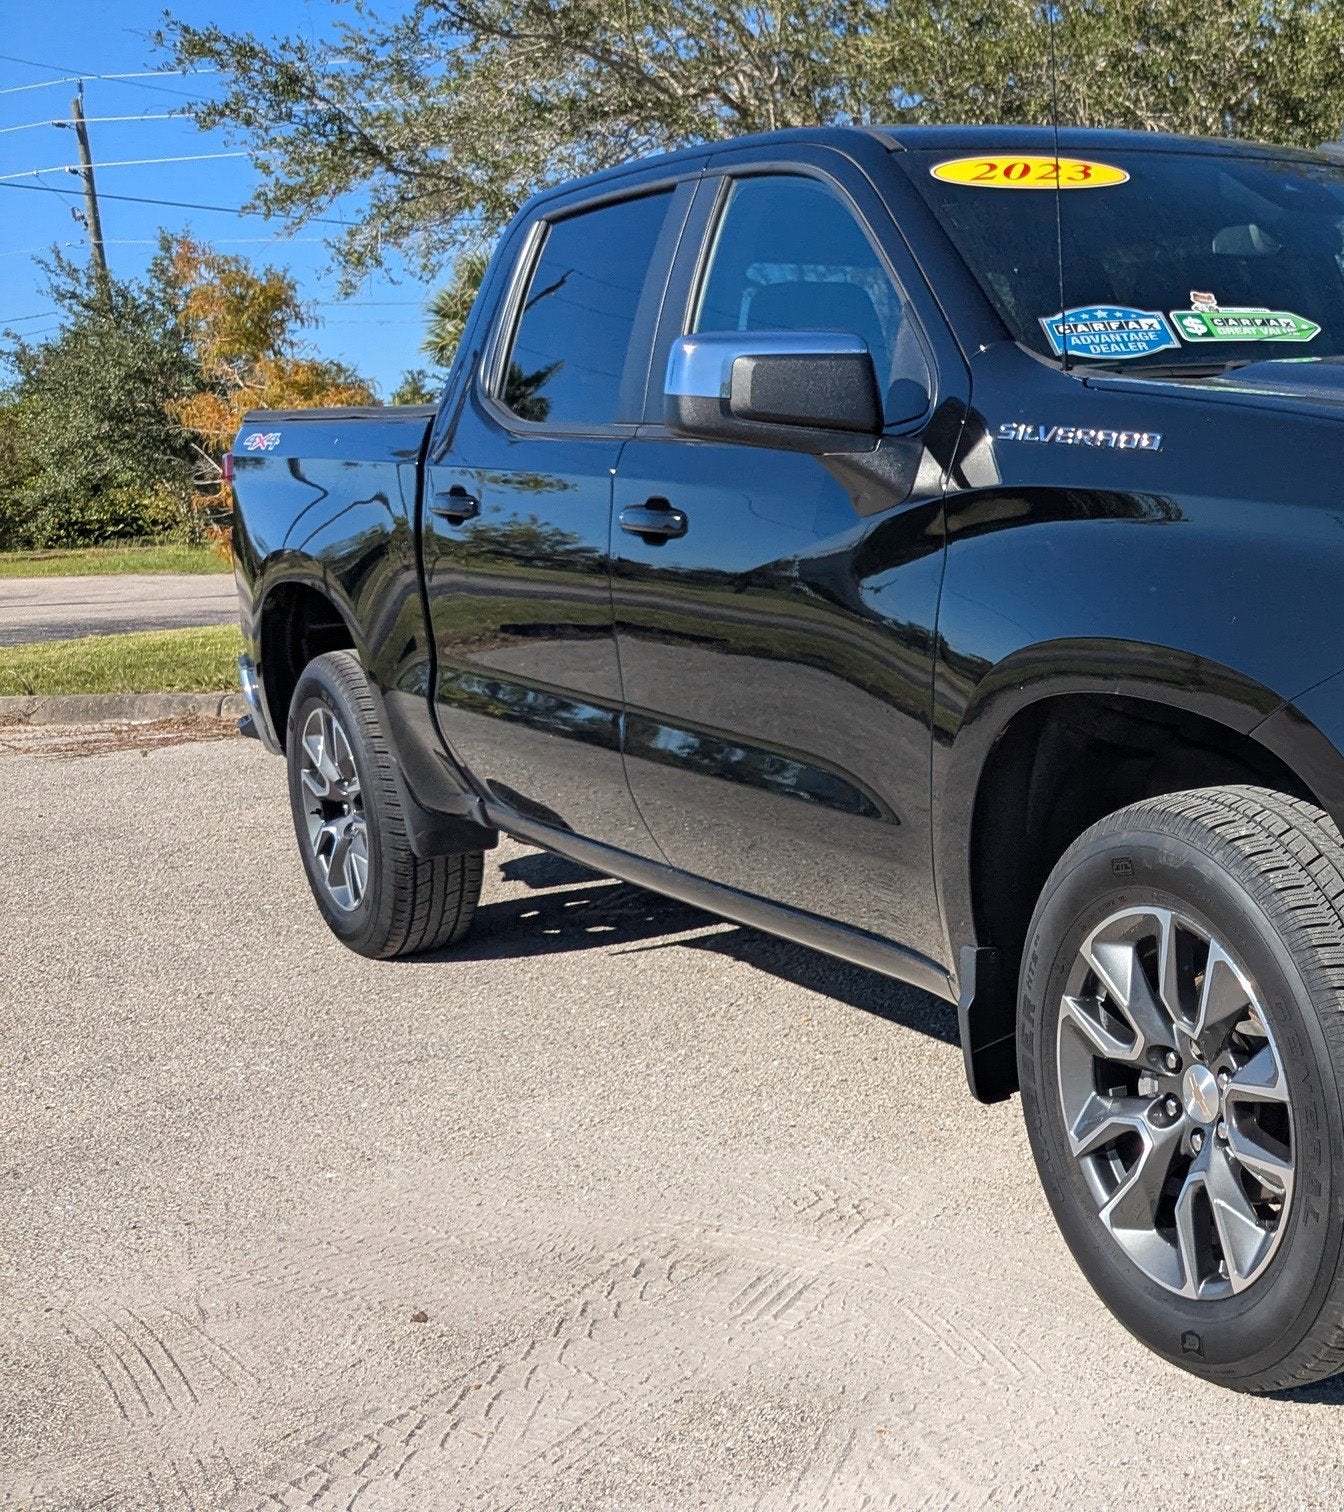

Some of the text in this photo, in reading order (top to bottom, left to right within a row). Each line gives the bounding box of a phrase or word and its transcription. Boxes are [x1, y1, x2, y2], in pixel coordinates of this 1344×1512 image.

[970, 162, 1093, 182] 2023
[1056, 320, 1159, 335] CARFAX
[1212, 317, 1296, 328] CARFAX
[1071, 331, 1158, 345] ADVANTAGE
[1216, 327, 1257, 336] GREAT
[1089, 342, 1149, 354] DEALER
[997, 422, 1164, 450] SILVERADO
